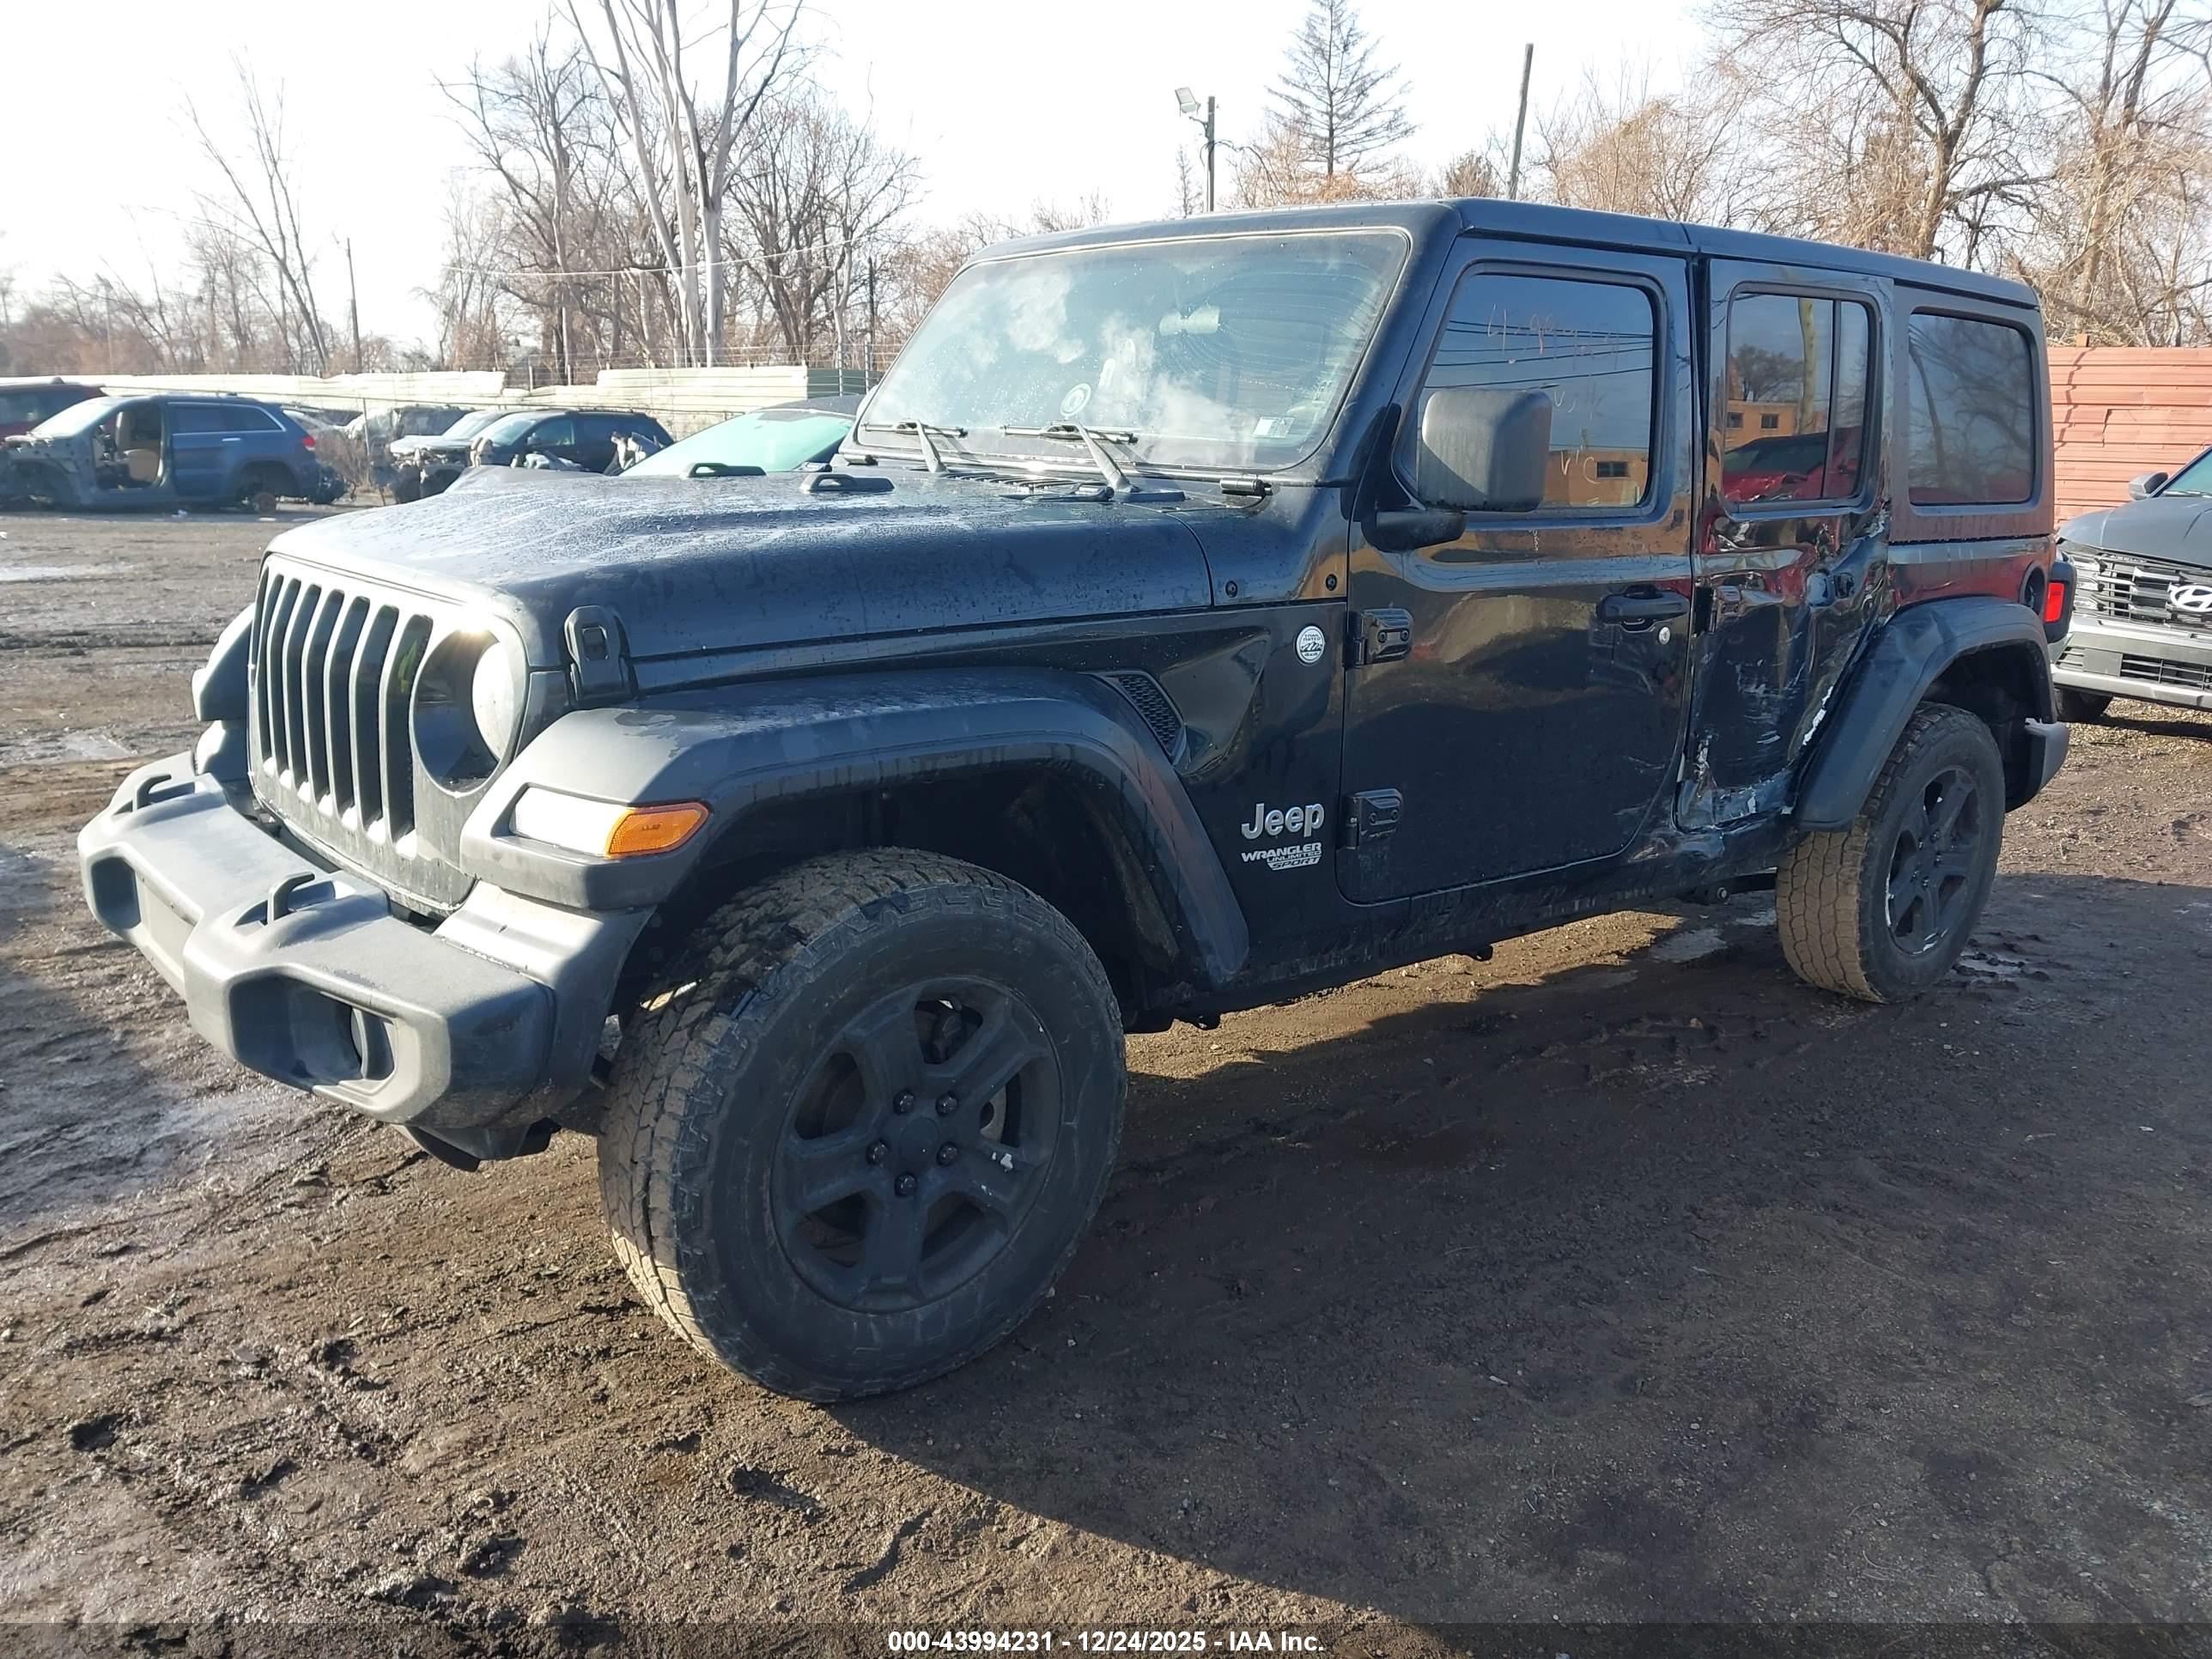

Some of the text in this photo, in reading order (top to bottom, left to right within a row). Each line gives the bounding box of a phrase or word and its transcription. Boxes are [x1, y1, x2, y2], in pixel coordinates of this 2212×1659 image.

[1241, 803, 1324, 840] Jeep
[1241, 842, 1322, 862] WRANGLER
[1267, 850, 1322, 863] UNLIMITED
[1269, 857, 1320, 869] SPORT
